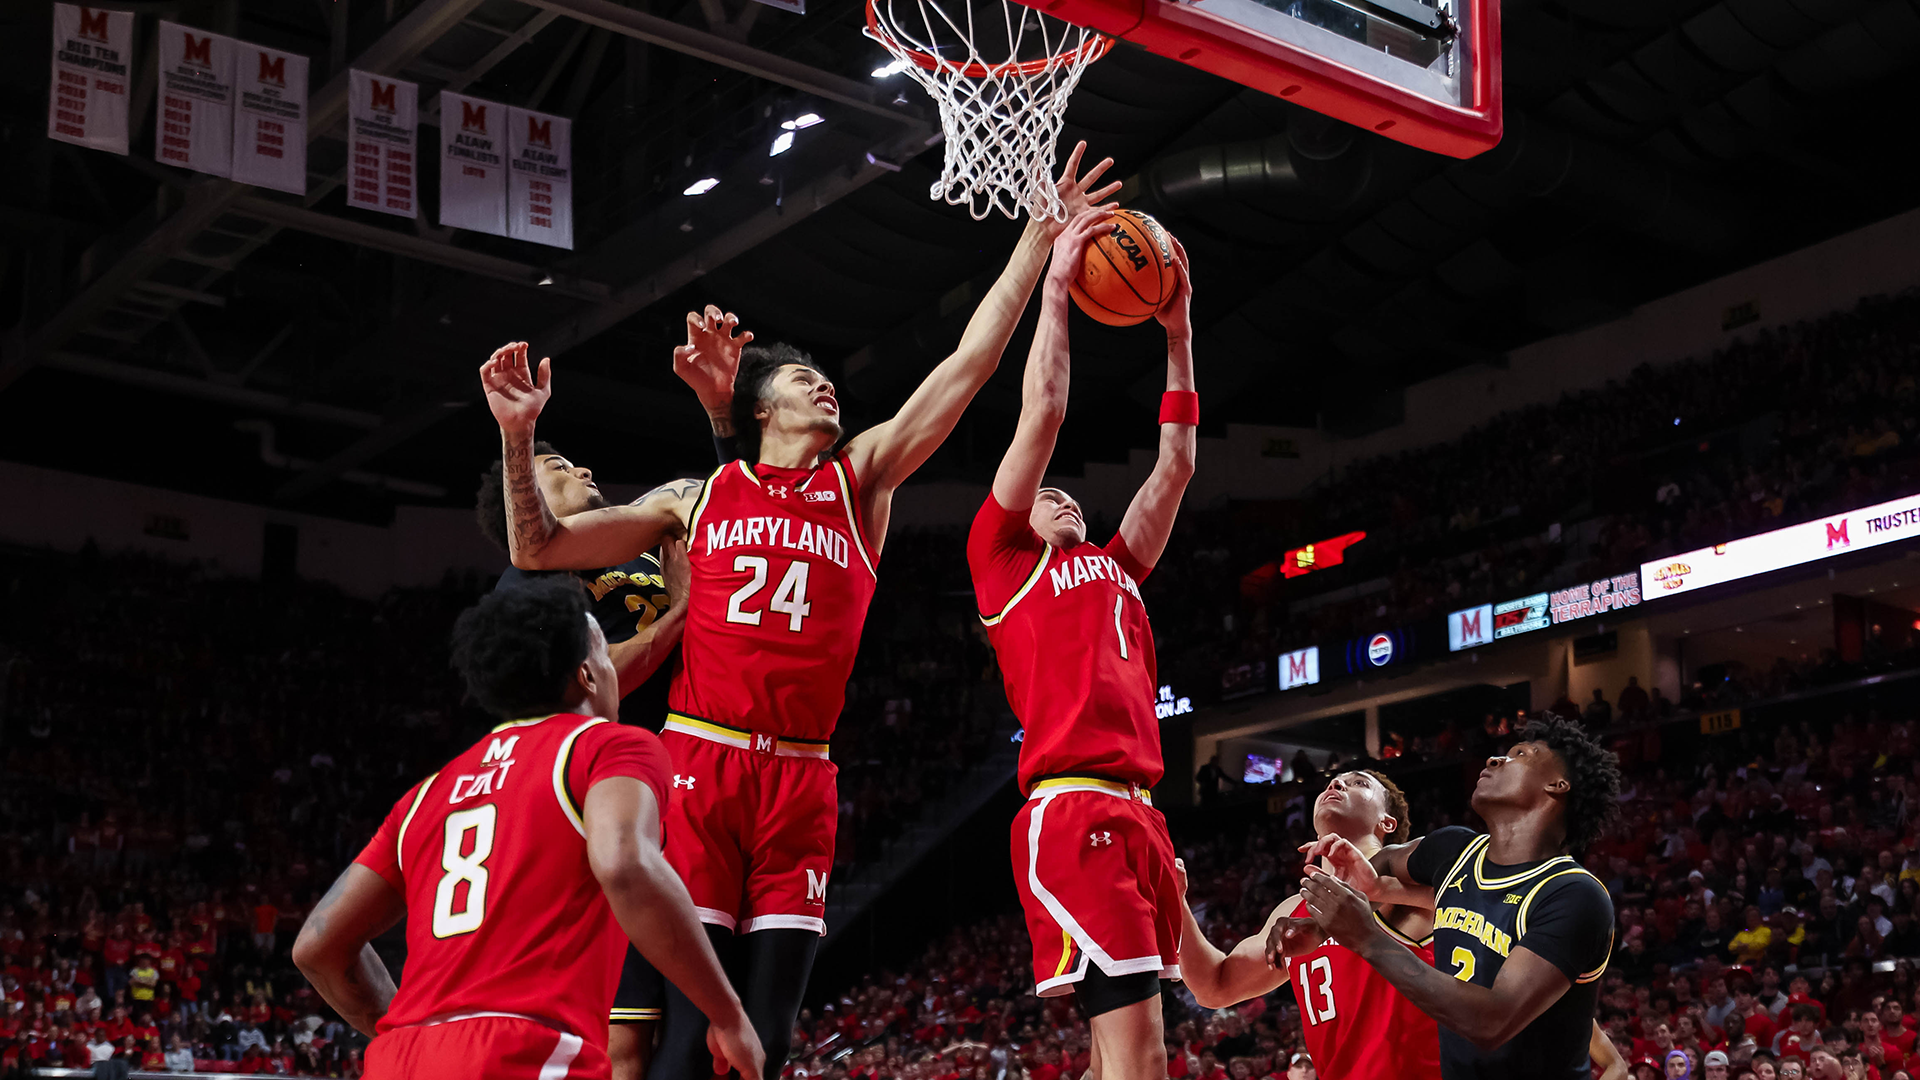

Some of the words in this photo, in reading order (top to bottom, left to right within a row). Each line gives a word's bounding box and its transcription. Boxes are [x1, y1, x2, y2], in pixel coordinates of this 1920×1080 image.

[80, 6, 109, 40] M
[58, 50, 126, 76] CHAMPIONS
[67, 40, 91, 55] BIG
[95, 46, 119, 62] TEN
[184, 32, 211, 65] M
[258, 52, 286, 84] M
[57, 97, 86, 111] 2017
[371, 79, 396, 111] M
[462, 100, 486, 132] M
[528, 116, 552, 147] M
[448, 145, 499, 165] FINALISTS
[455, 133, 493, 150] AIAW
[522, 148, 559, 165] AIAW
[512, 158, 537, 174] ELITE
[540, 164, 567, 179] EIGHT
[1109, 223, 1150, 272] NCAA
[1825, 518, 1851, 548] M
[1866, 507, 1920, 534] TRUSTE
[706, 516, 849, 569] MARYLAND
[726, 554, 812, 633] 24
[1550, 584, 1590, 607] HOME
[1591, 579, 1610, 597] OF
[1611, 573, 1638, 592] THE
[1550, 588, 1642, 624] TERRAPINS
[1113, 593, 1129, 661] 1
[1461, 609, 1483, 642] M
[1289, 651, 1307, 682] M
[1174, 697, 1194, 715] JR.
[482, 735, 521, 764] M
[755, 733, 772, 752] M
[432, 803, 498, 940] 8
[806, 868, 827, 904] M
[1300, 955, 1337, 1026] 13
